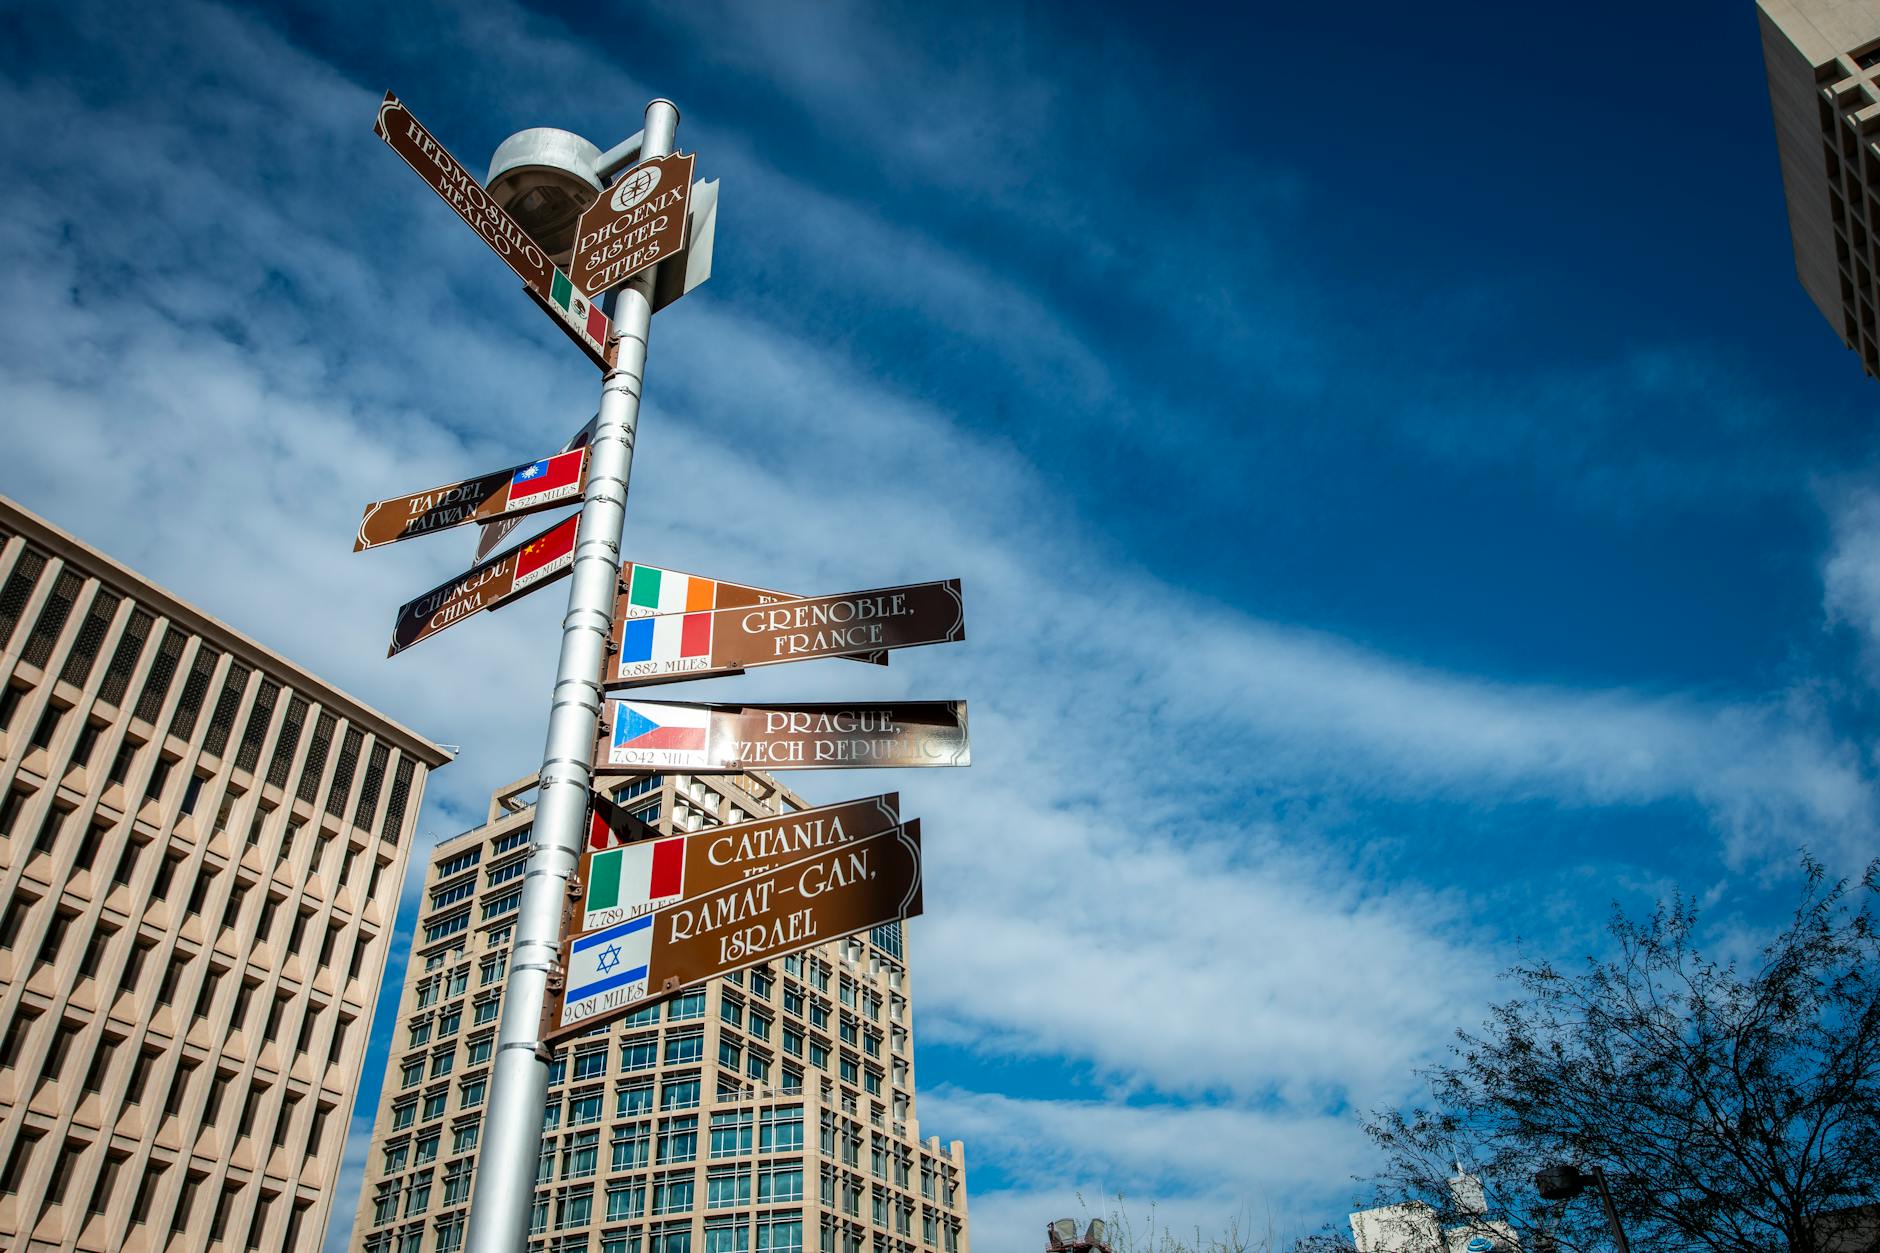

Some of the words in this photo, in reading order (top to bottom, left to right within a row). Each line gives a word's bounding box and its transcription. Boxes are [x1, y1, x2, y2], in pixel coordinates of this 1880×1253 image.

[406, 121, 545, 275] HERMOSILLO,
[438, 176, 510, 254] MEXICO
[579, 185, 685, 254] PHOENIX
[586, 216, 668, 271] SISTER
[586, 240, 660, 292] CITIES
[543, 484, 577, 502] MILES
[405, 501, 480, 534] TAIWAN
[542, 556, 572, 575] MILES
[430, 591, 482, 630] CHINA
[742, 592, 915, 634] GRENOBLE,
[773, 623, 883, 656] FRANCE
[665, 657, 708, 672] MILES
[765, 710, 901, 734] PRAGUE,
[668, 849, 877, 945] RAMAT-GAN,
[718, 908, 817, 965] ISRAEL
[602, 982, 644, 1010] MILES
